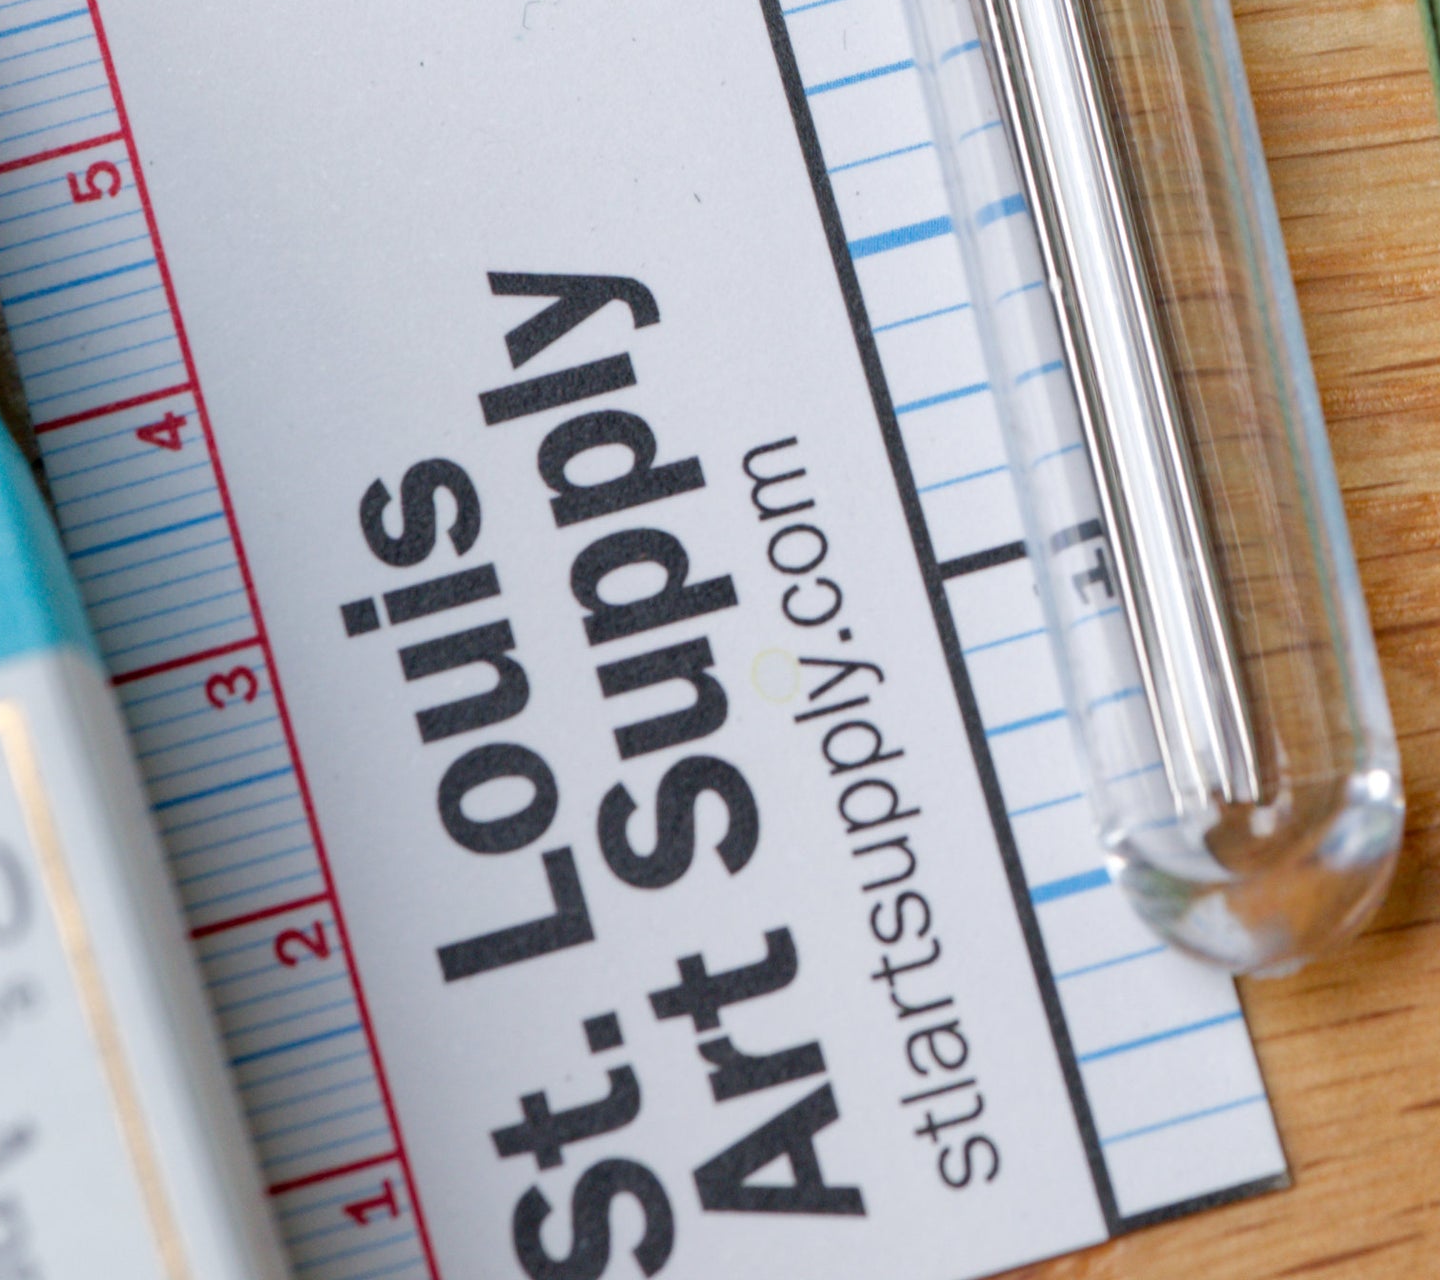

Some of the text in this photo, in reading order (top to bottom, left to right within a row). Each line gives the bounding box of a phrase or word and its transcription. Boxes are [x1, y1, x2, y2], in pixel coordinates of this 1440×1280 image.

[67, 158, 123, 206] 5
[135, 409, 186, 455] 4
[207, 666, 258, 711] 3
[477, 270, 867, 1217] Art Supply
[741, 436, 1001, 1191] stlartsupply.com
[340, 457, 675, 1280] St. Louis
[276, 920, 329, 969] 2
[346, 1184, 403, 1228] 1
